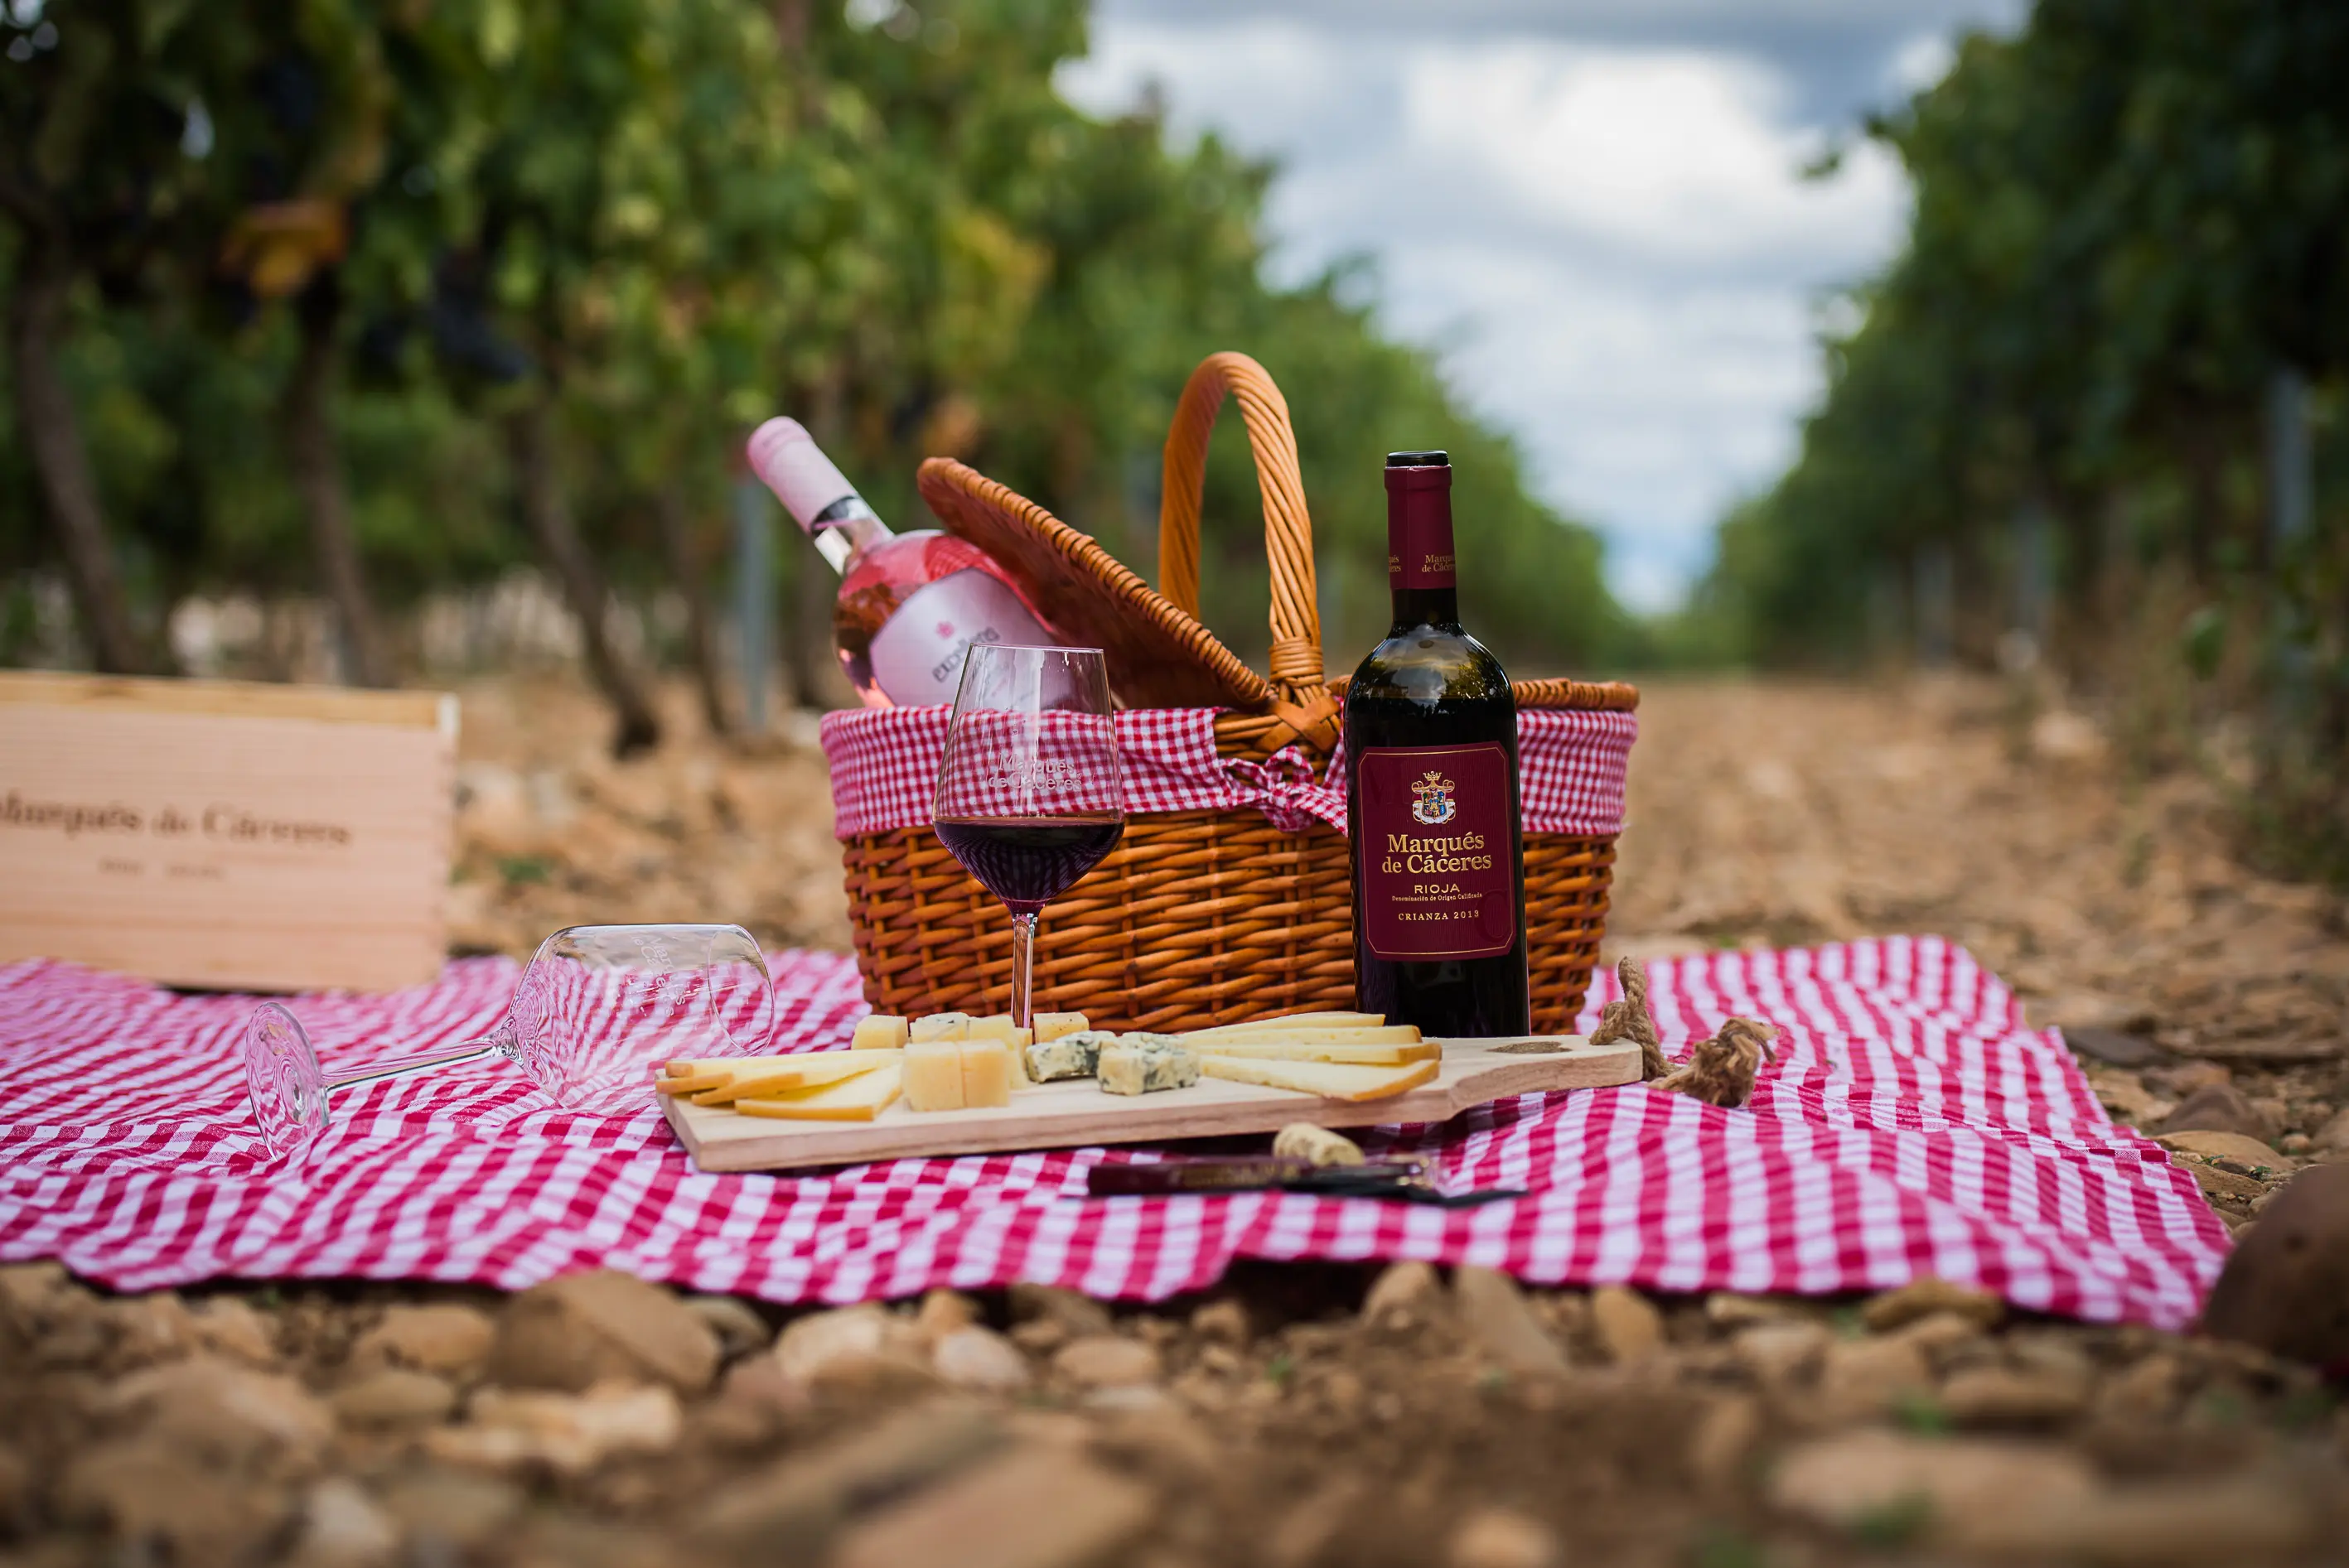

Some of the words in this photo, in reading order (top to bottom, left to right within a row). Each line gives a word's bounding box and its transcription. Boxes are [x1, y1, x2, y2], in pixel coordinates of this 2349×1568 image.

[1421, 564, 1432, 573] de
[1387, 832, 1485, 856] Marqués
[1382, 856, 1402, 873] de
[1407, 854, 1492, 874] Cáceres
[1414, 884, 1460, 894] RIOJA
[1398, 912, 1449, 920] CRIANZA
[1453, 910, 1479, 919] 2013
